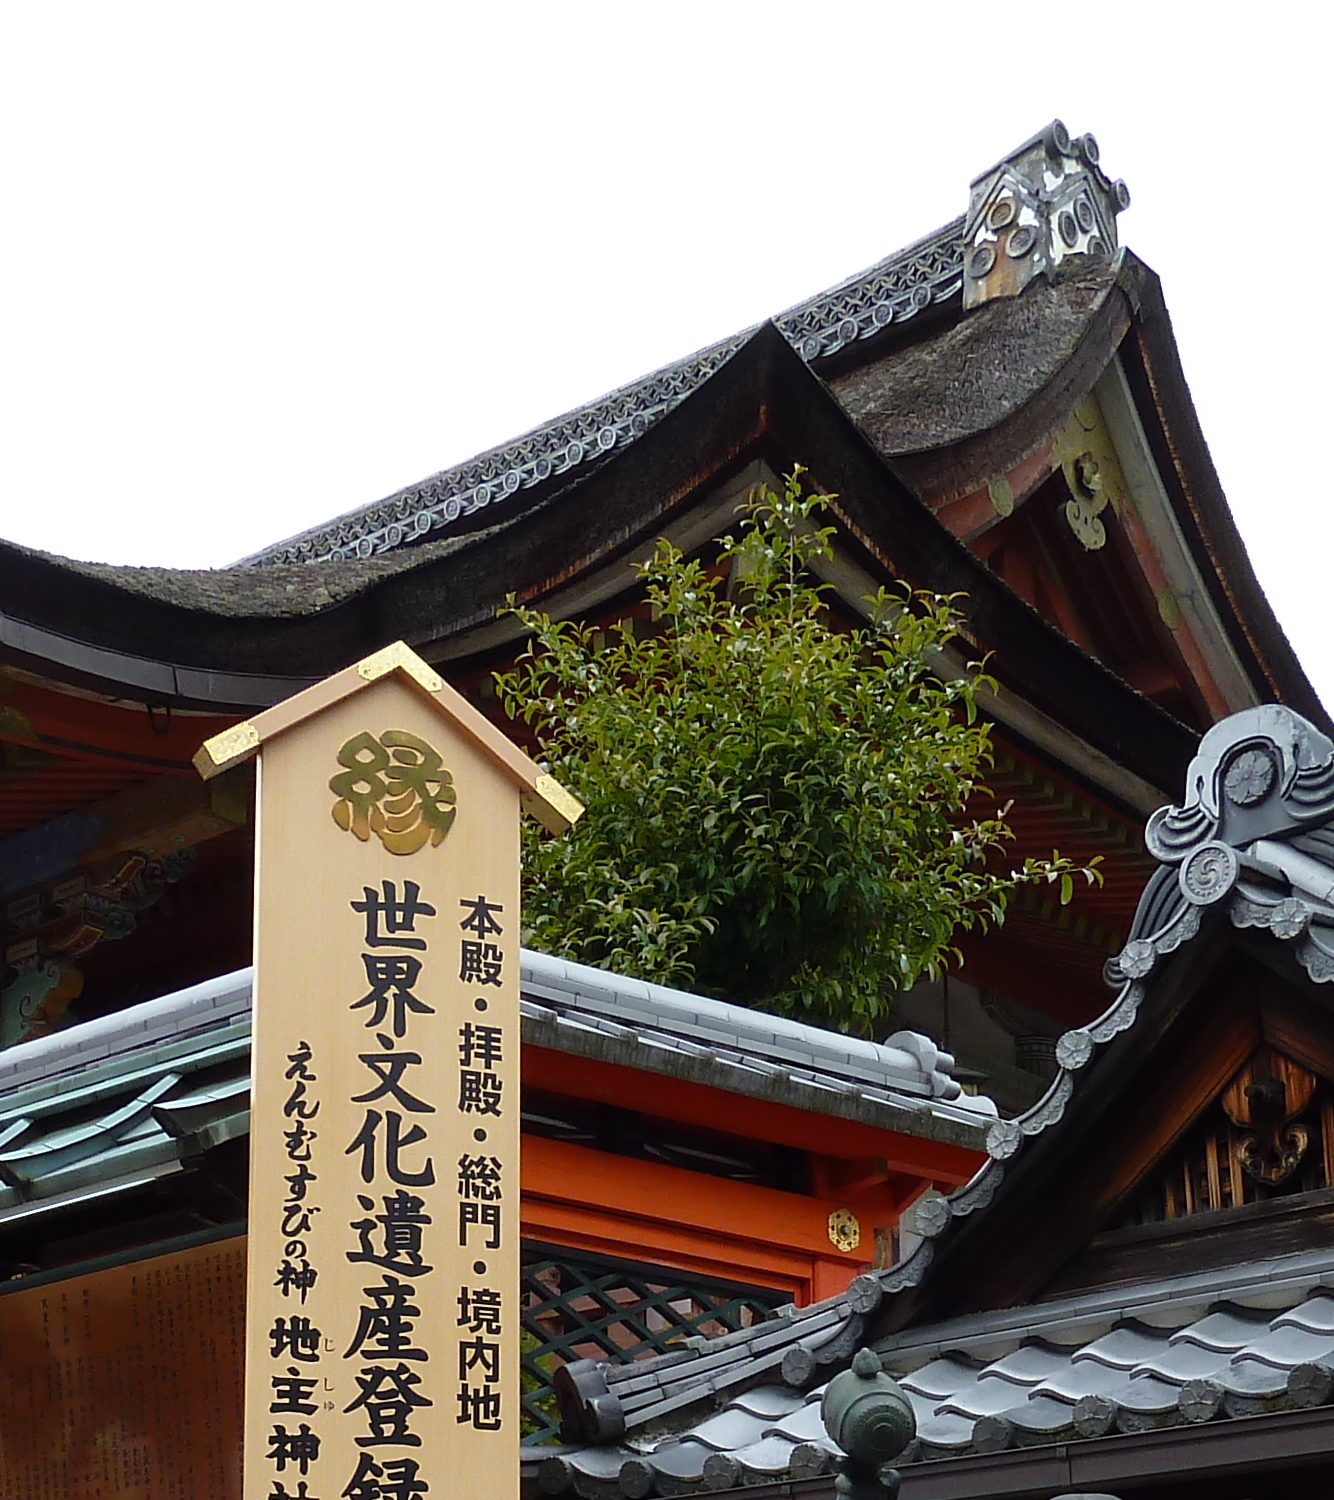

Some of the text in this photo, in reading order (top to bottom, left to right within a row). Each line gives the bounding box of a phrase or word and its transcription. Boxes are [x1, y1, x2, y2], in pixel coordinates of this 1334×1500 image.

[459, 895, 504, 1432] 本殿・拝殿・総門・境内地
